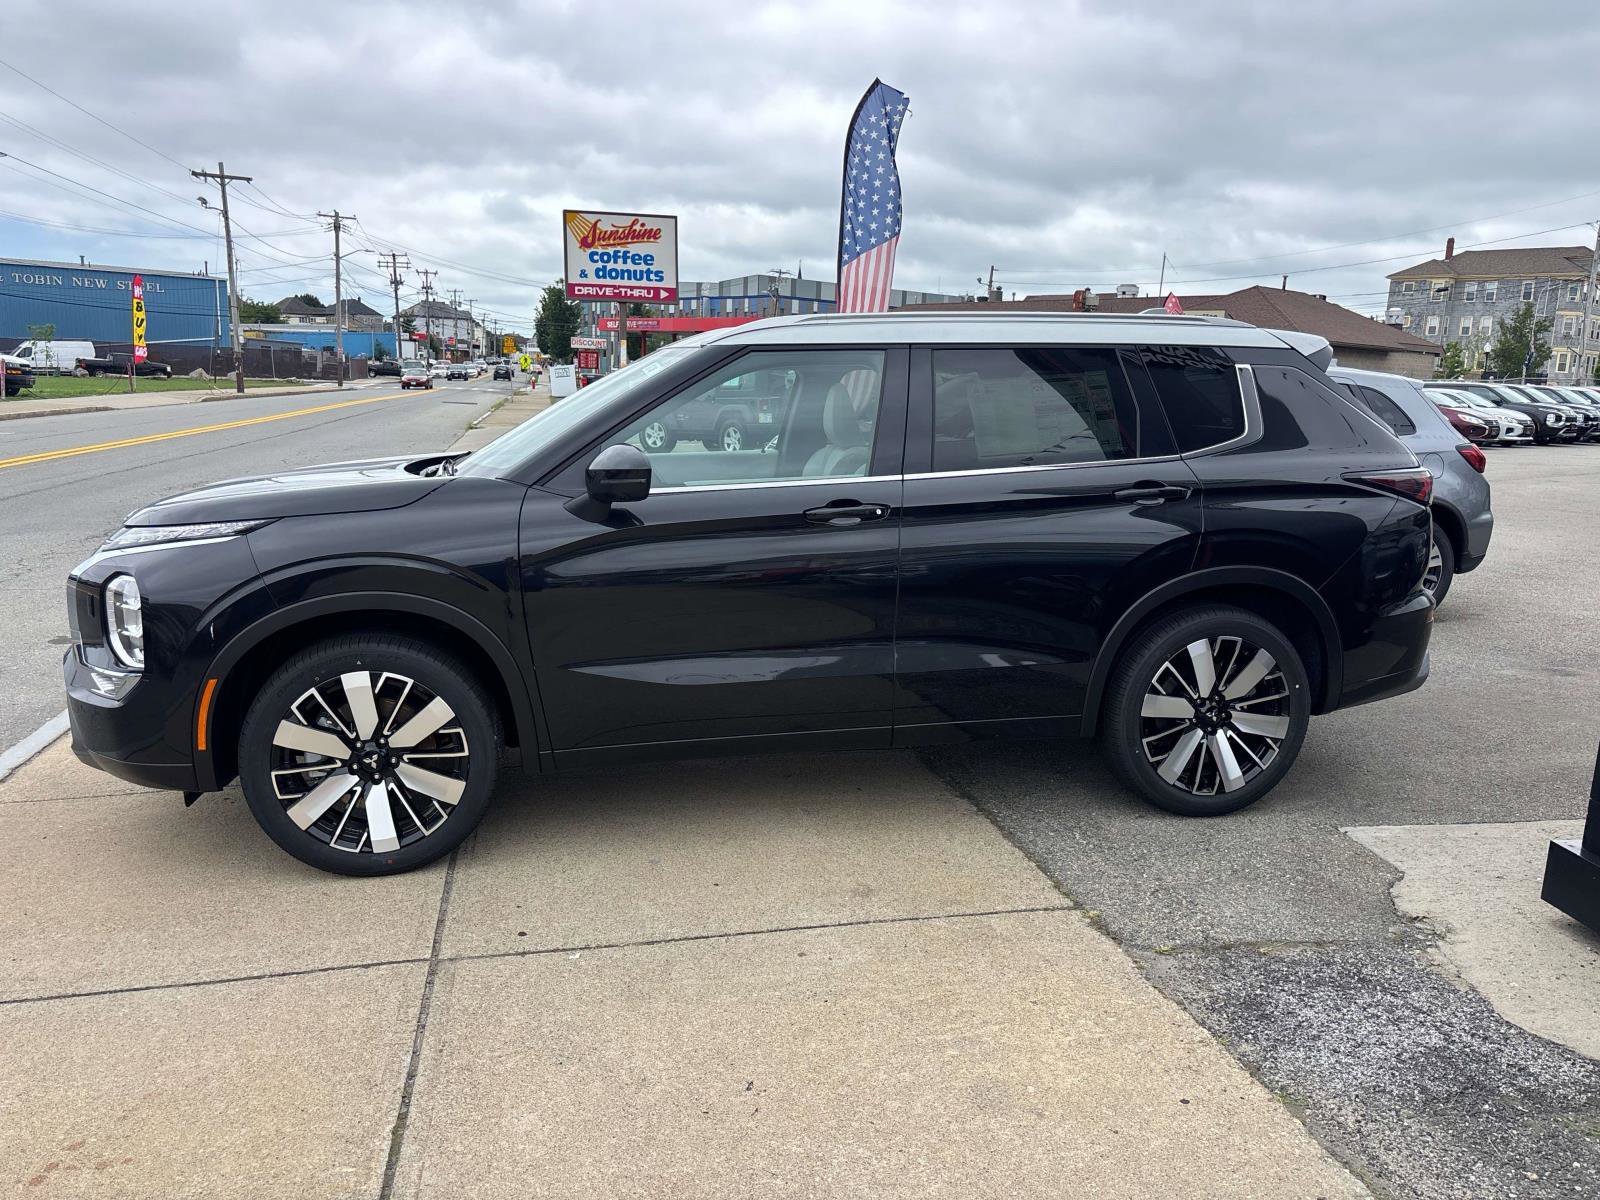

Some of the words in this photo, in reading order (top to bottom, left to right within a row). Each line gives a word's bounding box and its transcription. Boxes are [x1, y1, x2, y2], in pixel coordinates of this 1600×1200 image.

[579, 218, 662, 248] Sunshine
[588, 250, 654, 266] coffee
[11, 272, 63, 286] TOBIN
[72, 276, 109, 289] NEW
[579, 269, 588, 279] &
[594, 265, 664, 282] donuts
[574, 286, 654, 298] DRIVE-THRU
[136, 302, 144, 343] BUY
[606, 320, 620, 329] SELF
[571, 340, 606, 348] DISCOUNT
